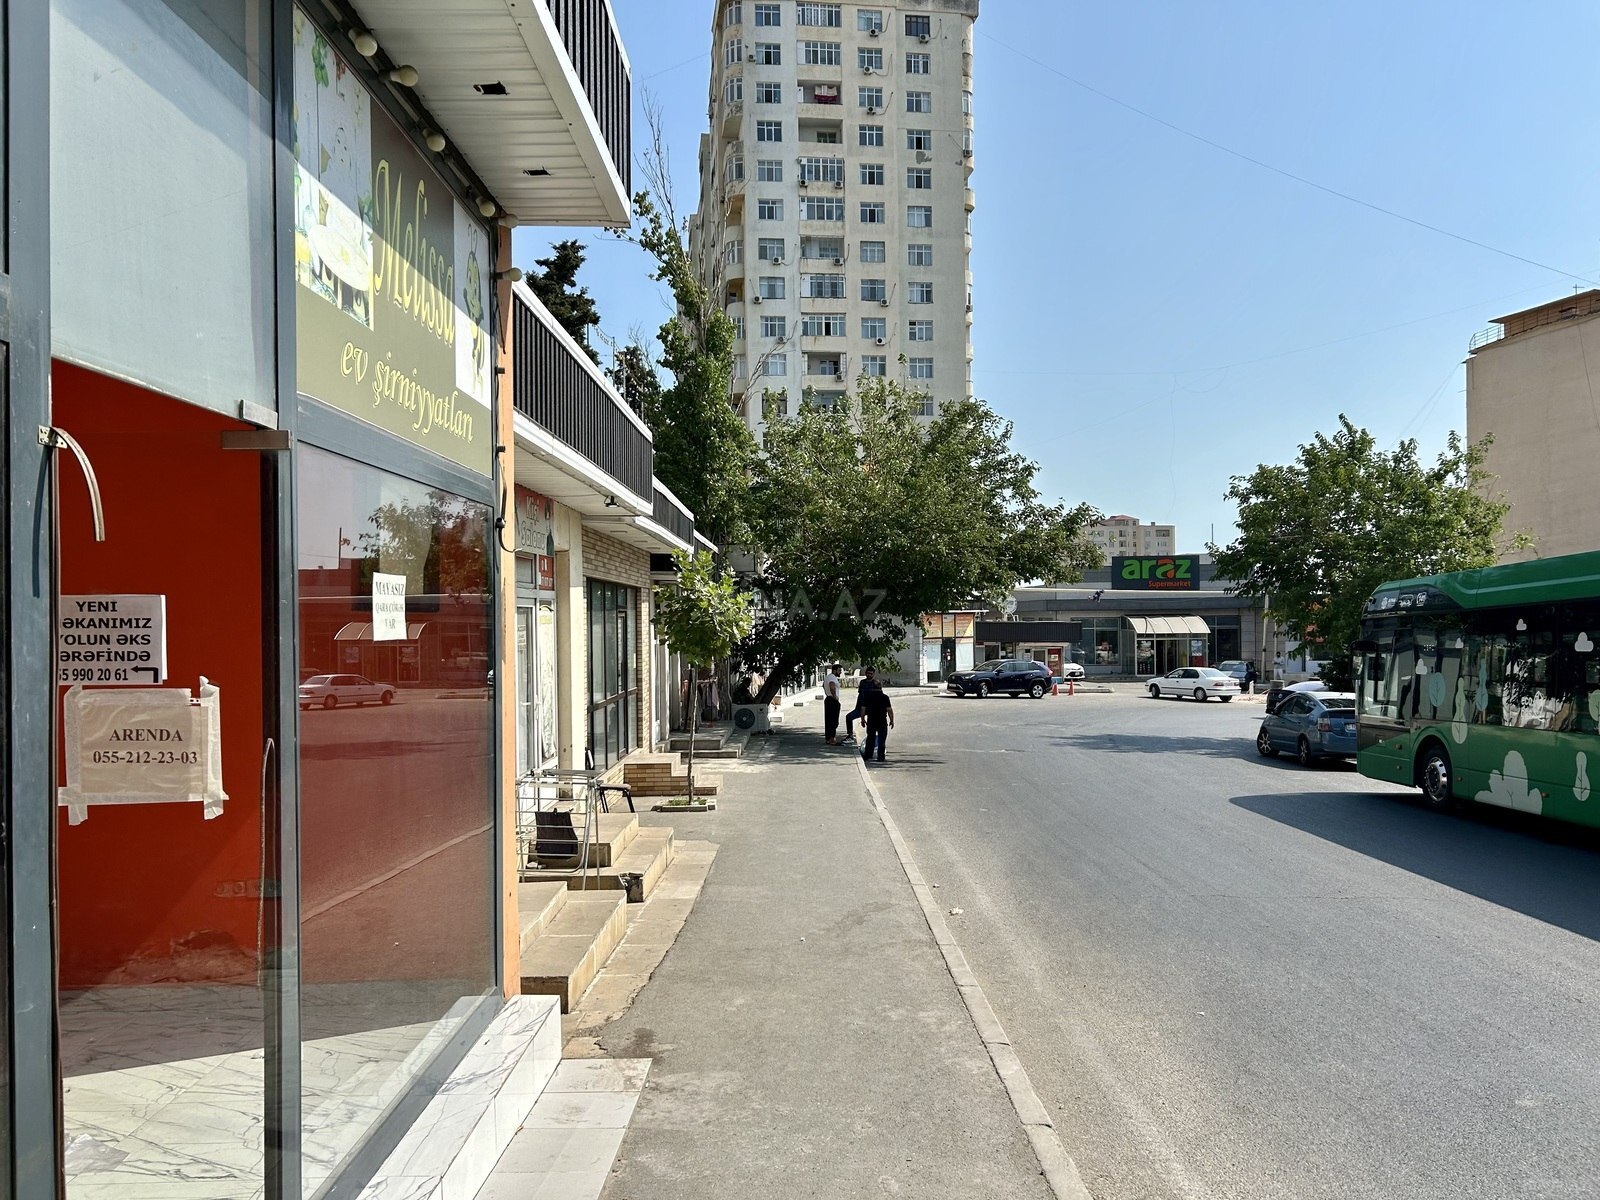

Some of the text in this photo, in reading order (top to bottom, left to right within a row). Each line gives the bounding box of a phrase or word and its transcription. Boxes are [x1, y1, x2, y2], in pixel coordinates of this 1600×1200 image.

[373, 159, 456, 348] Melissa
[340, 340, 369, 385] ev
[1121, 558, 1191, 580] araz
[375, 581, 405, 596] MAYASIZ
[1148, 580, 1191, 588] Supermarket
[60, 617, 152, 629] ƏKANIMIZ
[116, 634, 151, 646] ƏKS
[60, 648, 151, 662] ƏRƏFİNDƏ
[72, 668, 93, 681] 990
[97, 668, 111, 681] 20
[115, 668, 129, 681] 61
[109, 728, 183, 742] ARENDA
[93, 751, 198, 764] 055-212-23-03
